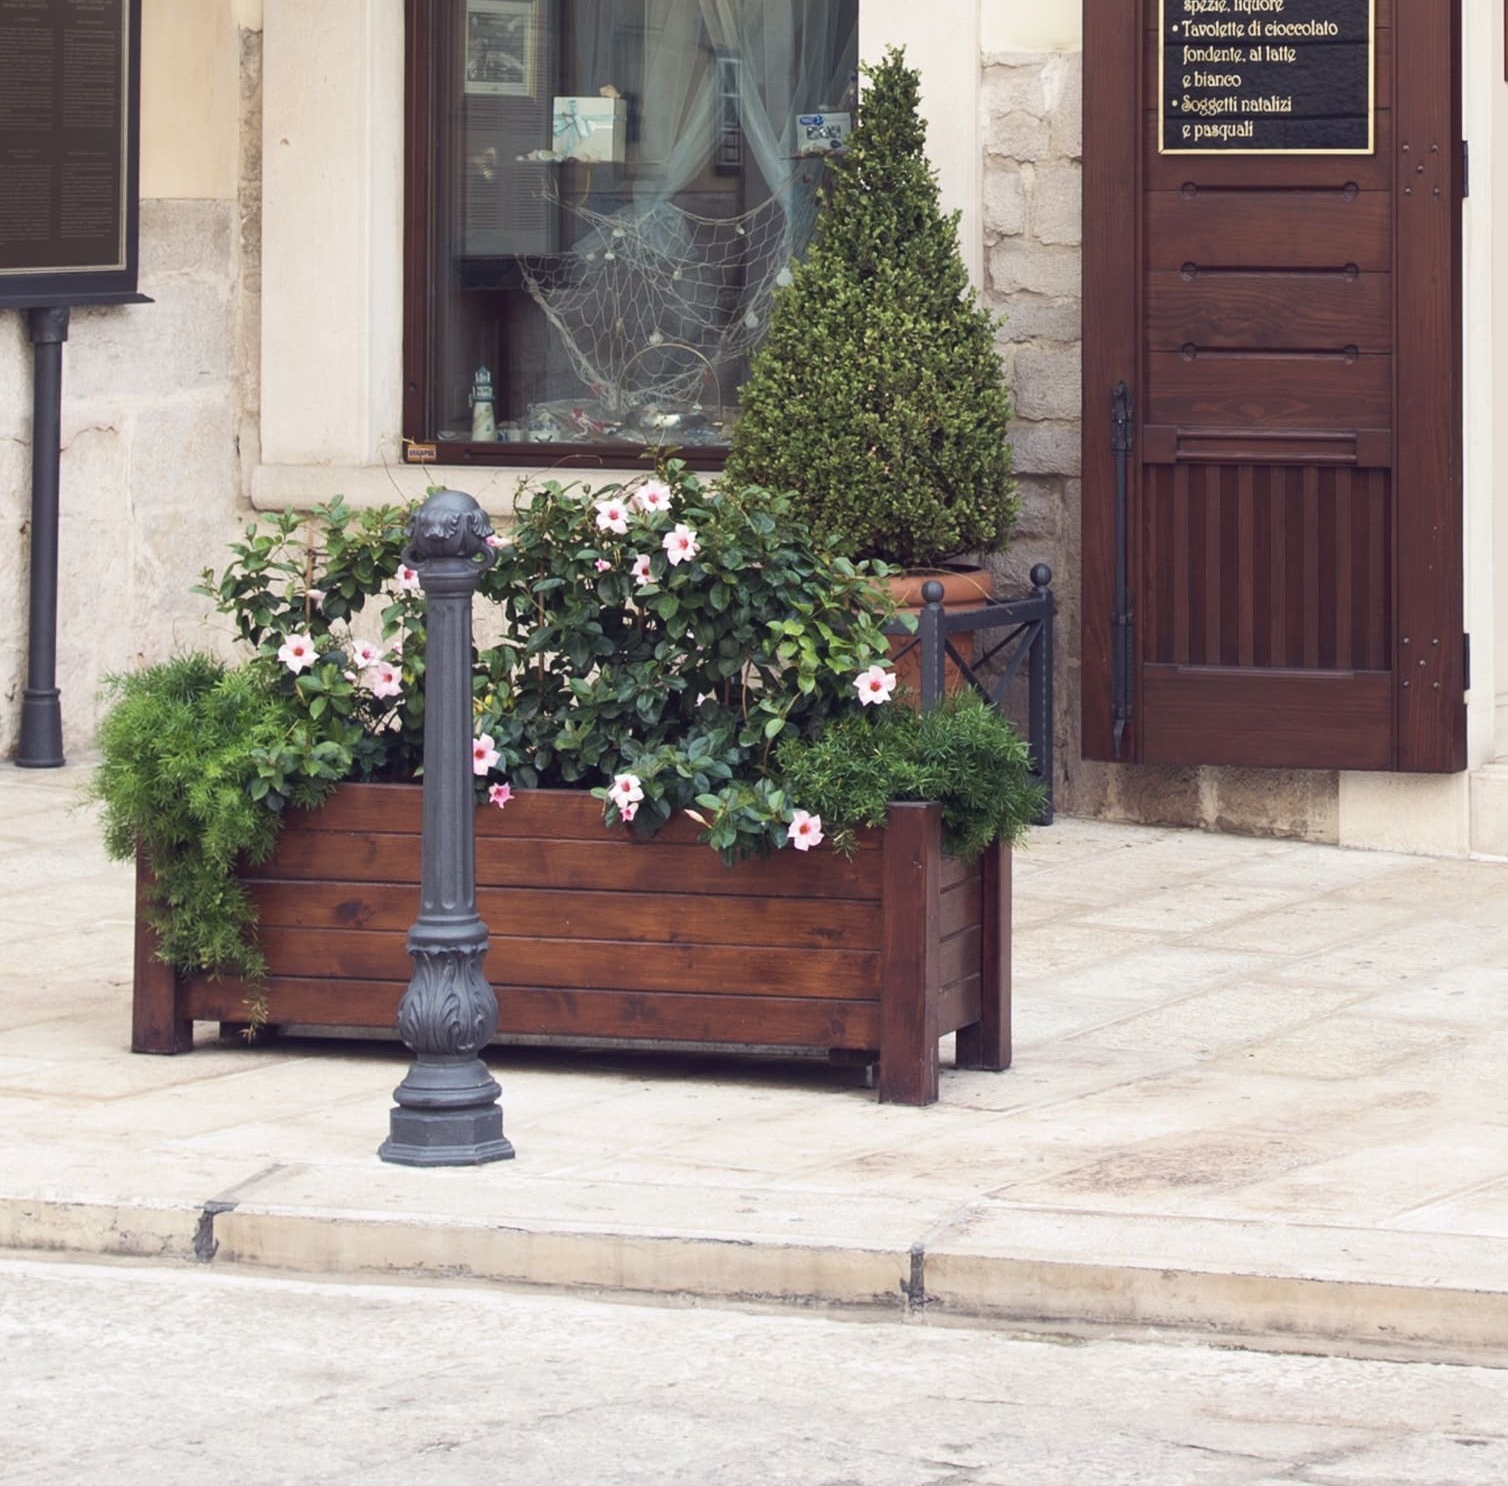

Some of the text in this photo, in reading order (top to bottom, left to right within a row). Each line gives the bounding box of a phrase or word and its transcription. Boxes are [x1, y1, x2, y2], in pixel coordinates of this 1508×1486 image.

[1181, 19, 1339, 38] Tavolette di cioccolato
[1249, 45, 1262, 62] al
[1266, 45, 1297, 63] latte
[1182, 71, 1242, 88] e bianco
[1181, 94, 1292, 116] Soggetti natalizi
[1182, 120, 1254, 141] e pasquali
